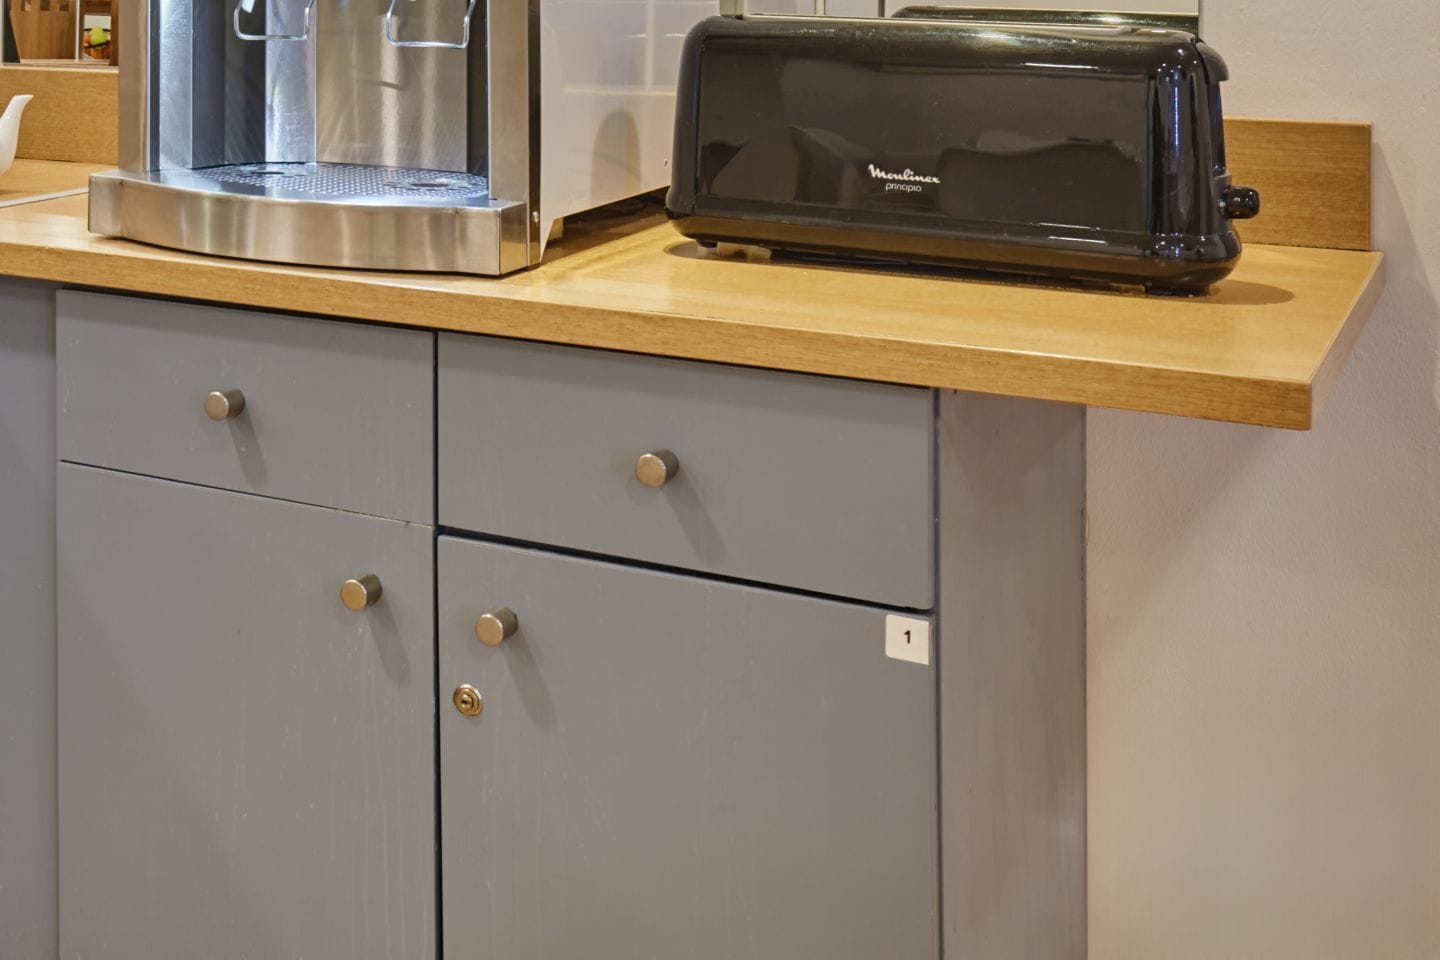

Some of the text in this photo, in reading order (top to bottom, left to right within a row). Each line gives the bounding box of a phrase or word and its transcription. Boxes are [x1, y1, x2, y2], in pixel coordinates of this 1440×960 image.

[868, 164, 941, 183] Moulinex
[885, 183, 922, 193] principio
[904, 630, 911, 644] 1
